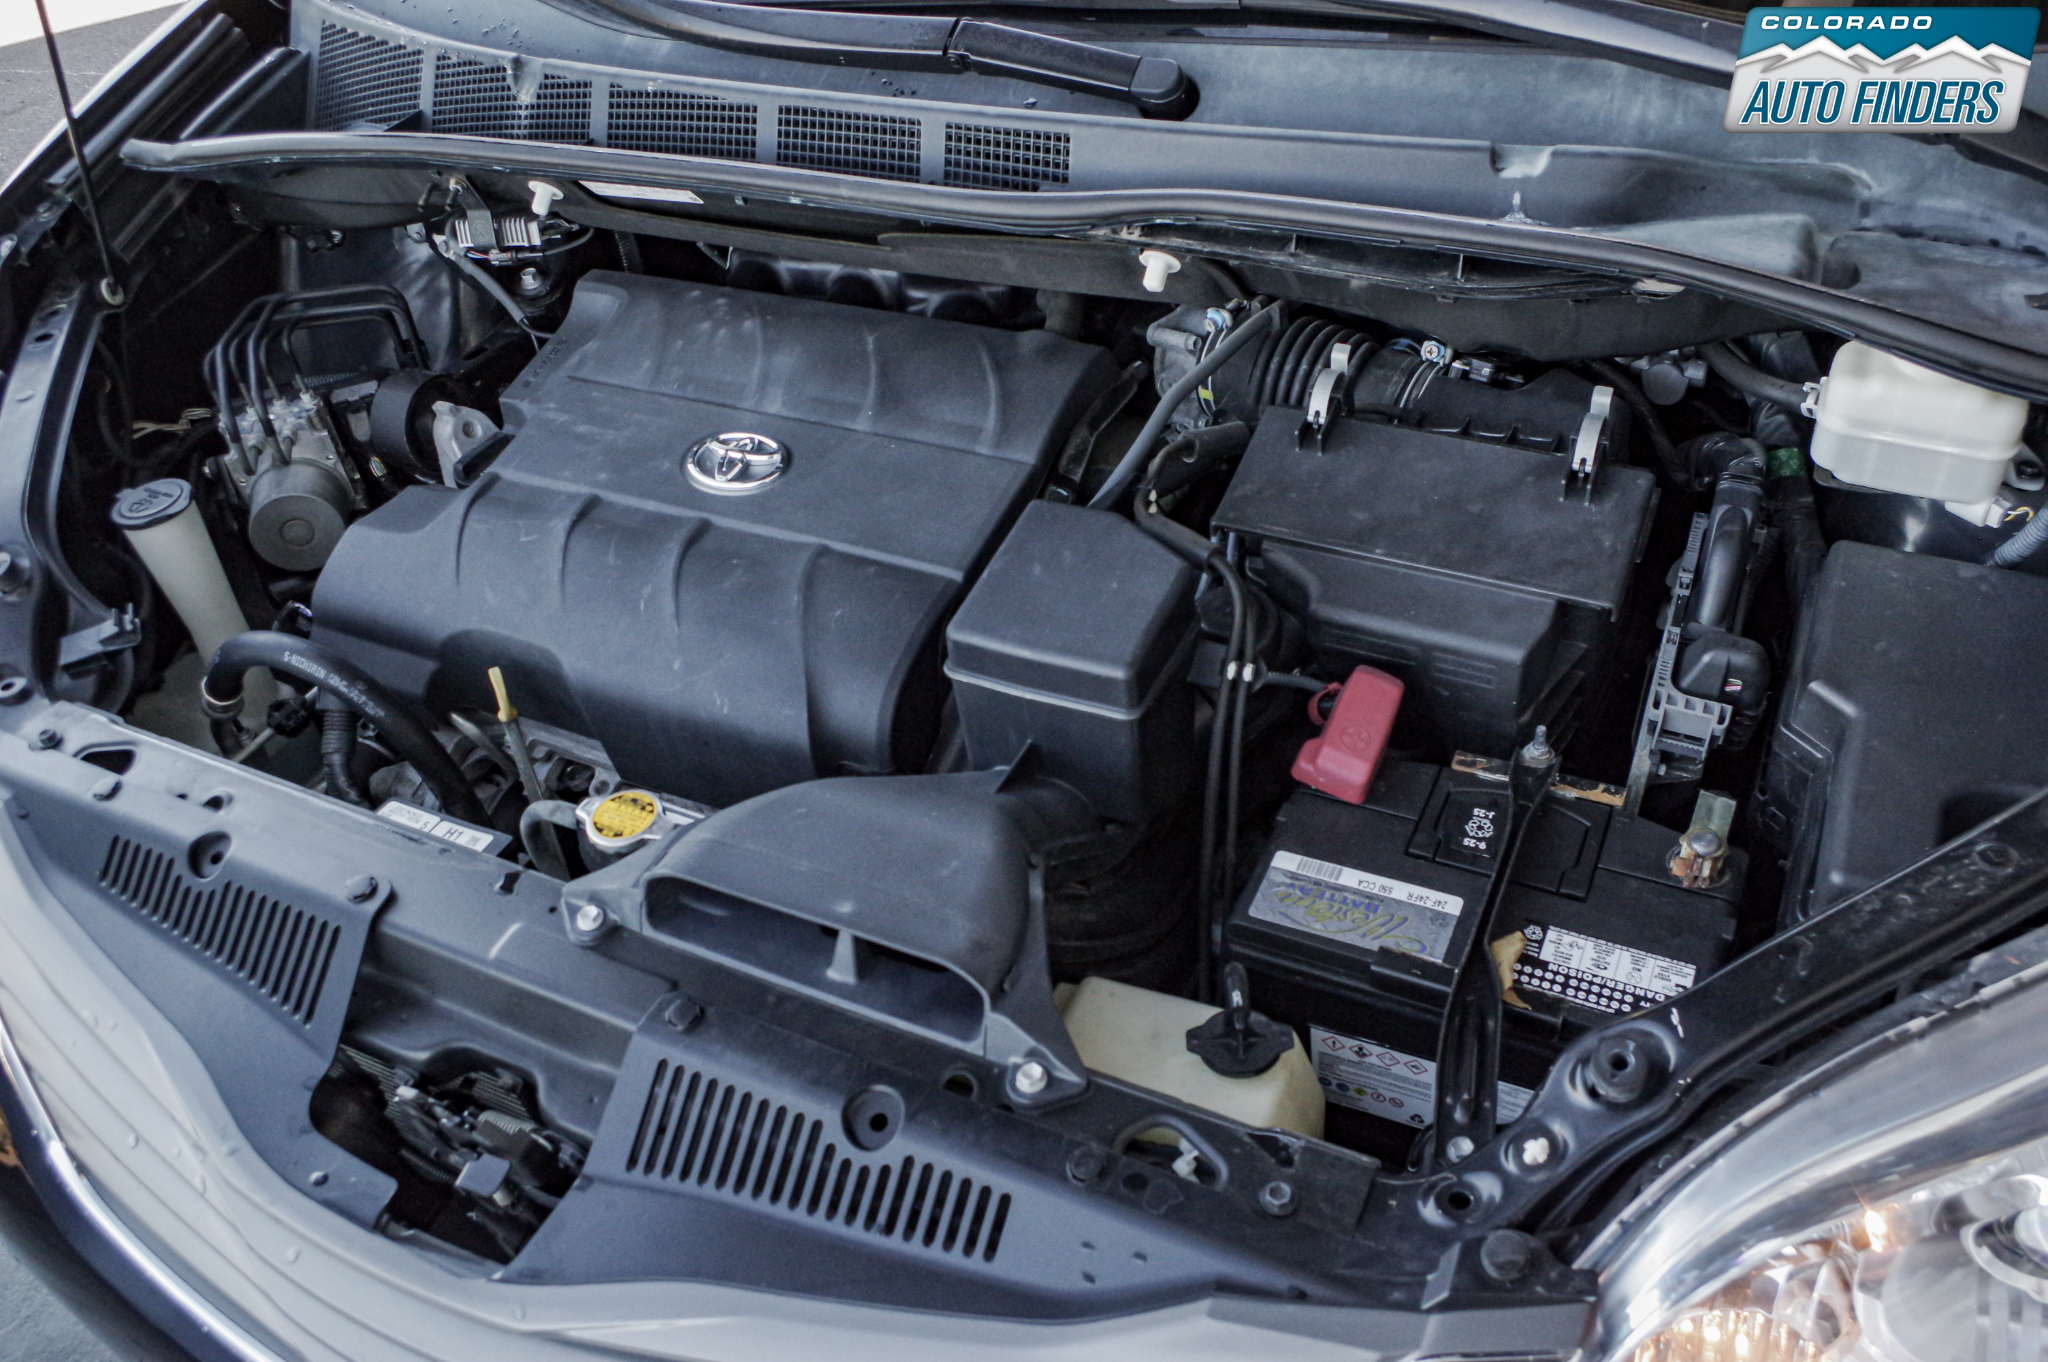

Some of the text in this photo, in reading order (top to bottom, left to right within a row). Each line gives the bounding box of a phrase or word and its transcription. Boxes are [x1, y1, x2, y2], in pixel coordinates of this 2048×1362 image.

[1473, 807, 1496, 819] J-25
[442, 827, 464, 841] H1
[1463, 837, 1487, 850] 9-25
[1357, 878, 1377, 890] CCA
[1378, 885, 1394, 895] 550
[1286, 882, 1382, 914] BATTERY
[1407, 891, 1448, 909] 24F-24FR
[1547, 963, 1666, 1002] DANGER/POISON
